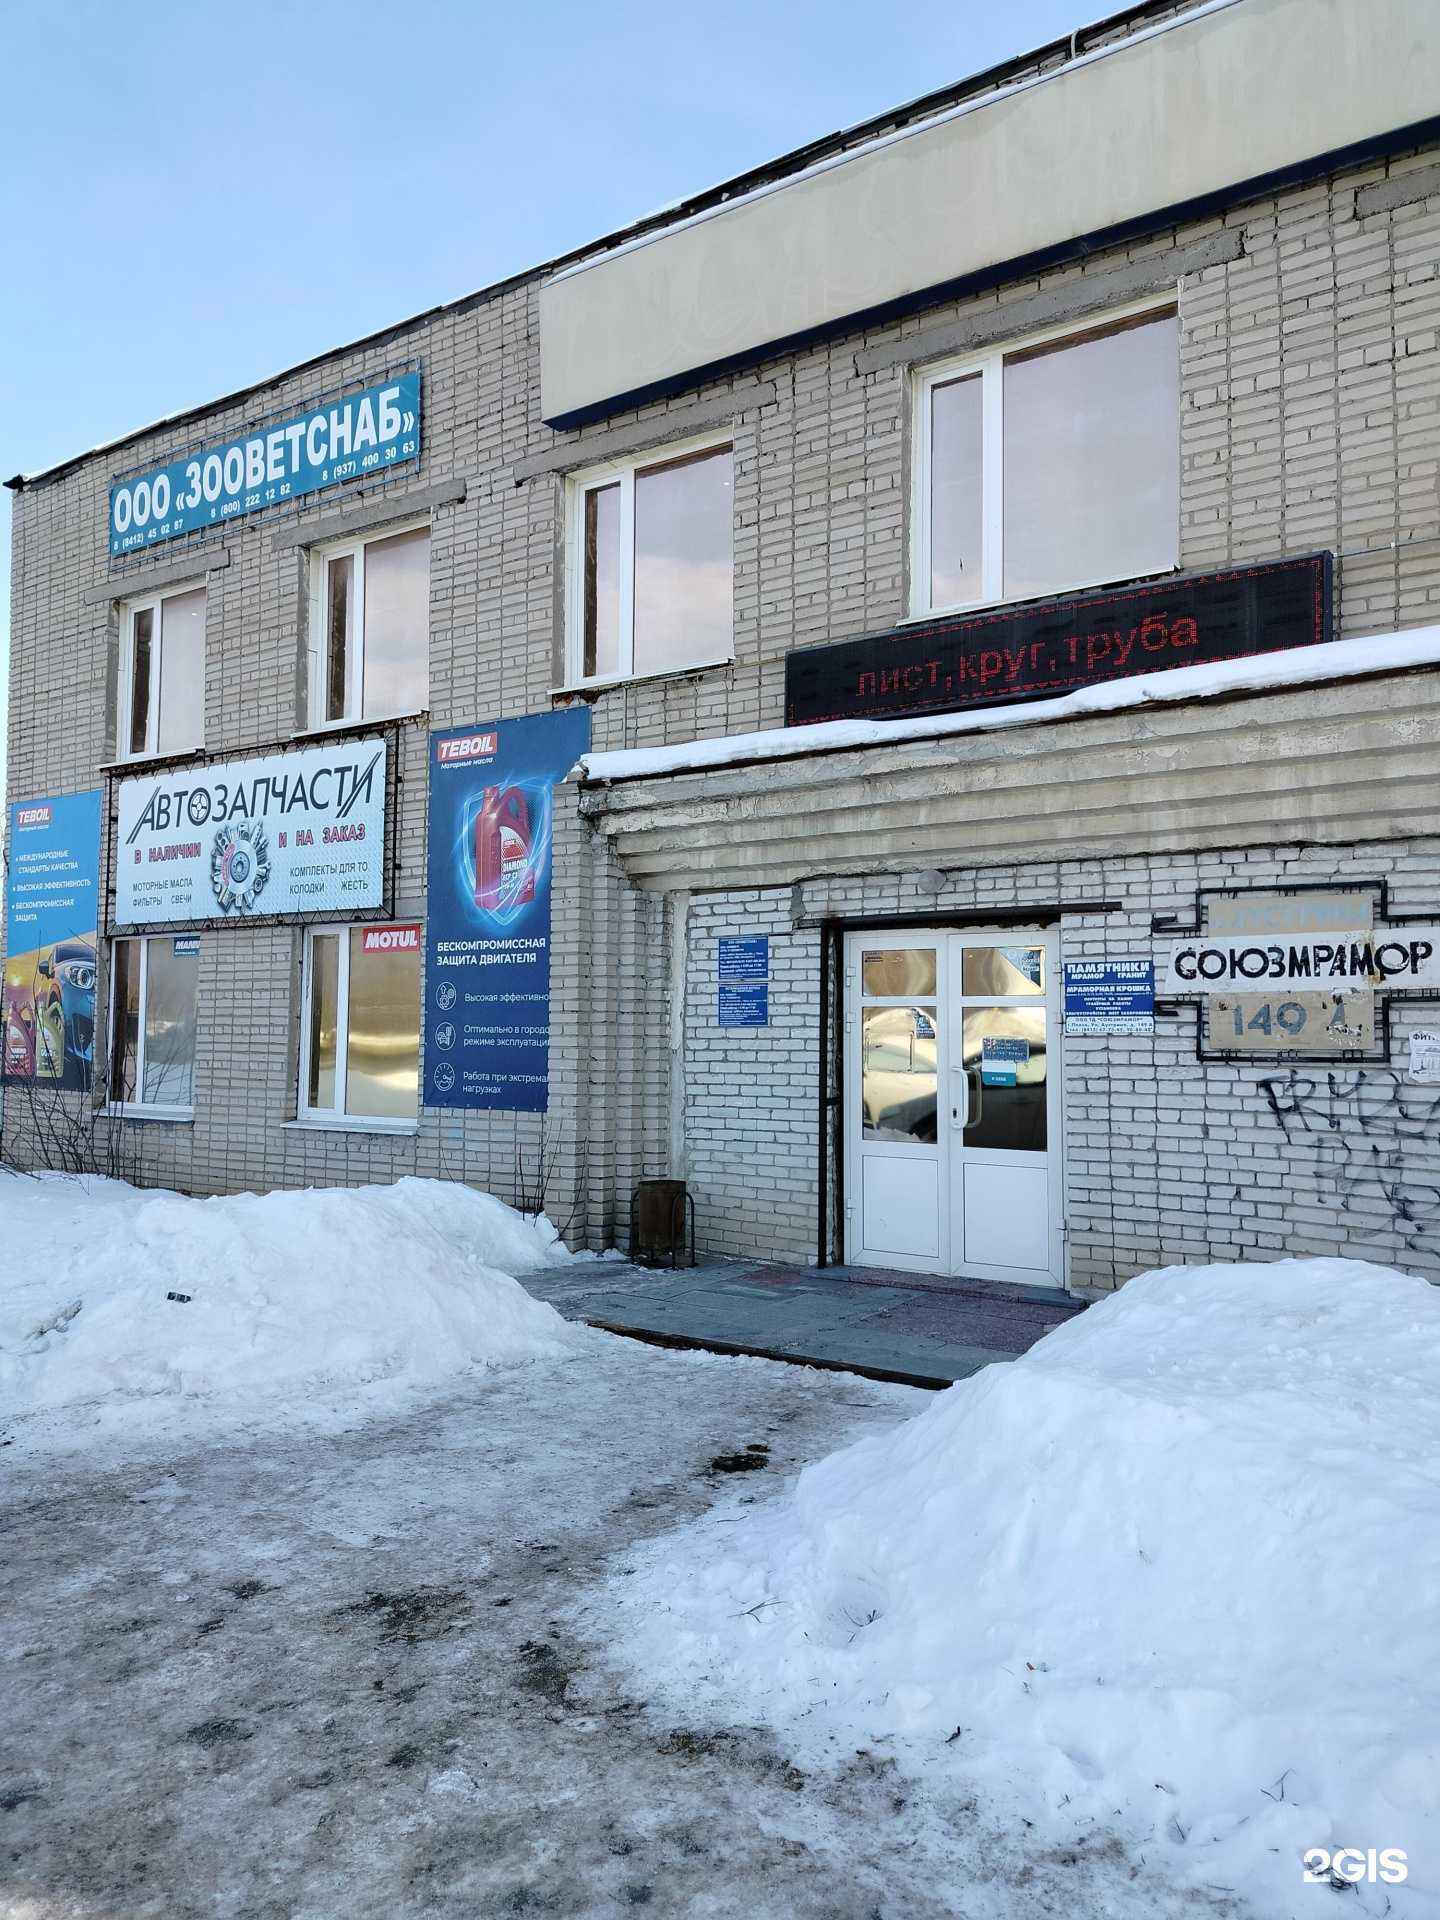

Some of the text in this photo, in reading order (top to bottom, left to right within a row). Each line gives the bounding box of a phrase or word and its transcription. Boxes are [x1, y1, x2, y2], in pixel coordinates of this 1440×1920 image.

[114, 386, 414, 533] ООО «ЗООВЕТСНАБ»
[322, 440, 415, 480] 8 (937) 400 30 63
[210, 508, 216, 518] 8
[220, 501, 240, 517] (800)
[245, 494, 260, 507] 222
[265, 489, 276, 500] 12
[148, 530, 157, 539] 45
[160, 524, 170, 534] 02
[440, 734, 494, 759] TEBOIL
[440, 757, 494, 770] Моторные масла
[126, 751, 382, 844] АВТОЗАПЧАСТИ
[18, 808, 50, 824] TEBOIL
[278, 823, 366, 848] И НА ЗАКАЗ
[134, 842, 202, 864] В НАЛИЧИИ
[290, 861, 368, 877] КОМПЛЕКТЫ ДЛЯ ТО
[132, 877, 193, 892] МОТОРНЫЕ МАСЛА
[289, 879, 369, 894] КОЛОДКИ ЖЕСТЬ
[132, 894, 192, 907] ФИЛЬТРЫ СВЕЧИ
[364, 930, 418, 949] MOTUL
[436, 937, 546, 952] БЕСКОМПРОМИССНАЯ
[436, 952, 537, 967] ЗАЩИТА ДВИГАТЕЛЯ
[1174, 941, 1433, 980] СОЮЗМРАМОР
[1067, 962, 1150, 974] ПАМЯТНИКИ
[1066, 984, 1151, 994] МРАМОРНАЯ КРОШКА
[464, 992, 498, 1002] Высокая
[1232, 1001, 1308, 1036] 149
[464, 1024, 514, 1034] Оптимально
[514, 1026, 520, 1034] в
[464, 1038, 496, 1048] режиме
[463, 1072, 490, 1081] Работа
[492, 1074, 507, 1083] при
[462, 1086, 502, 1095] нагрузках
